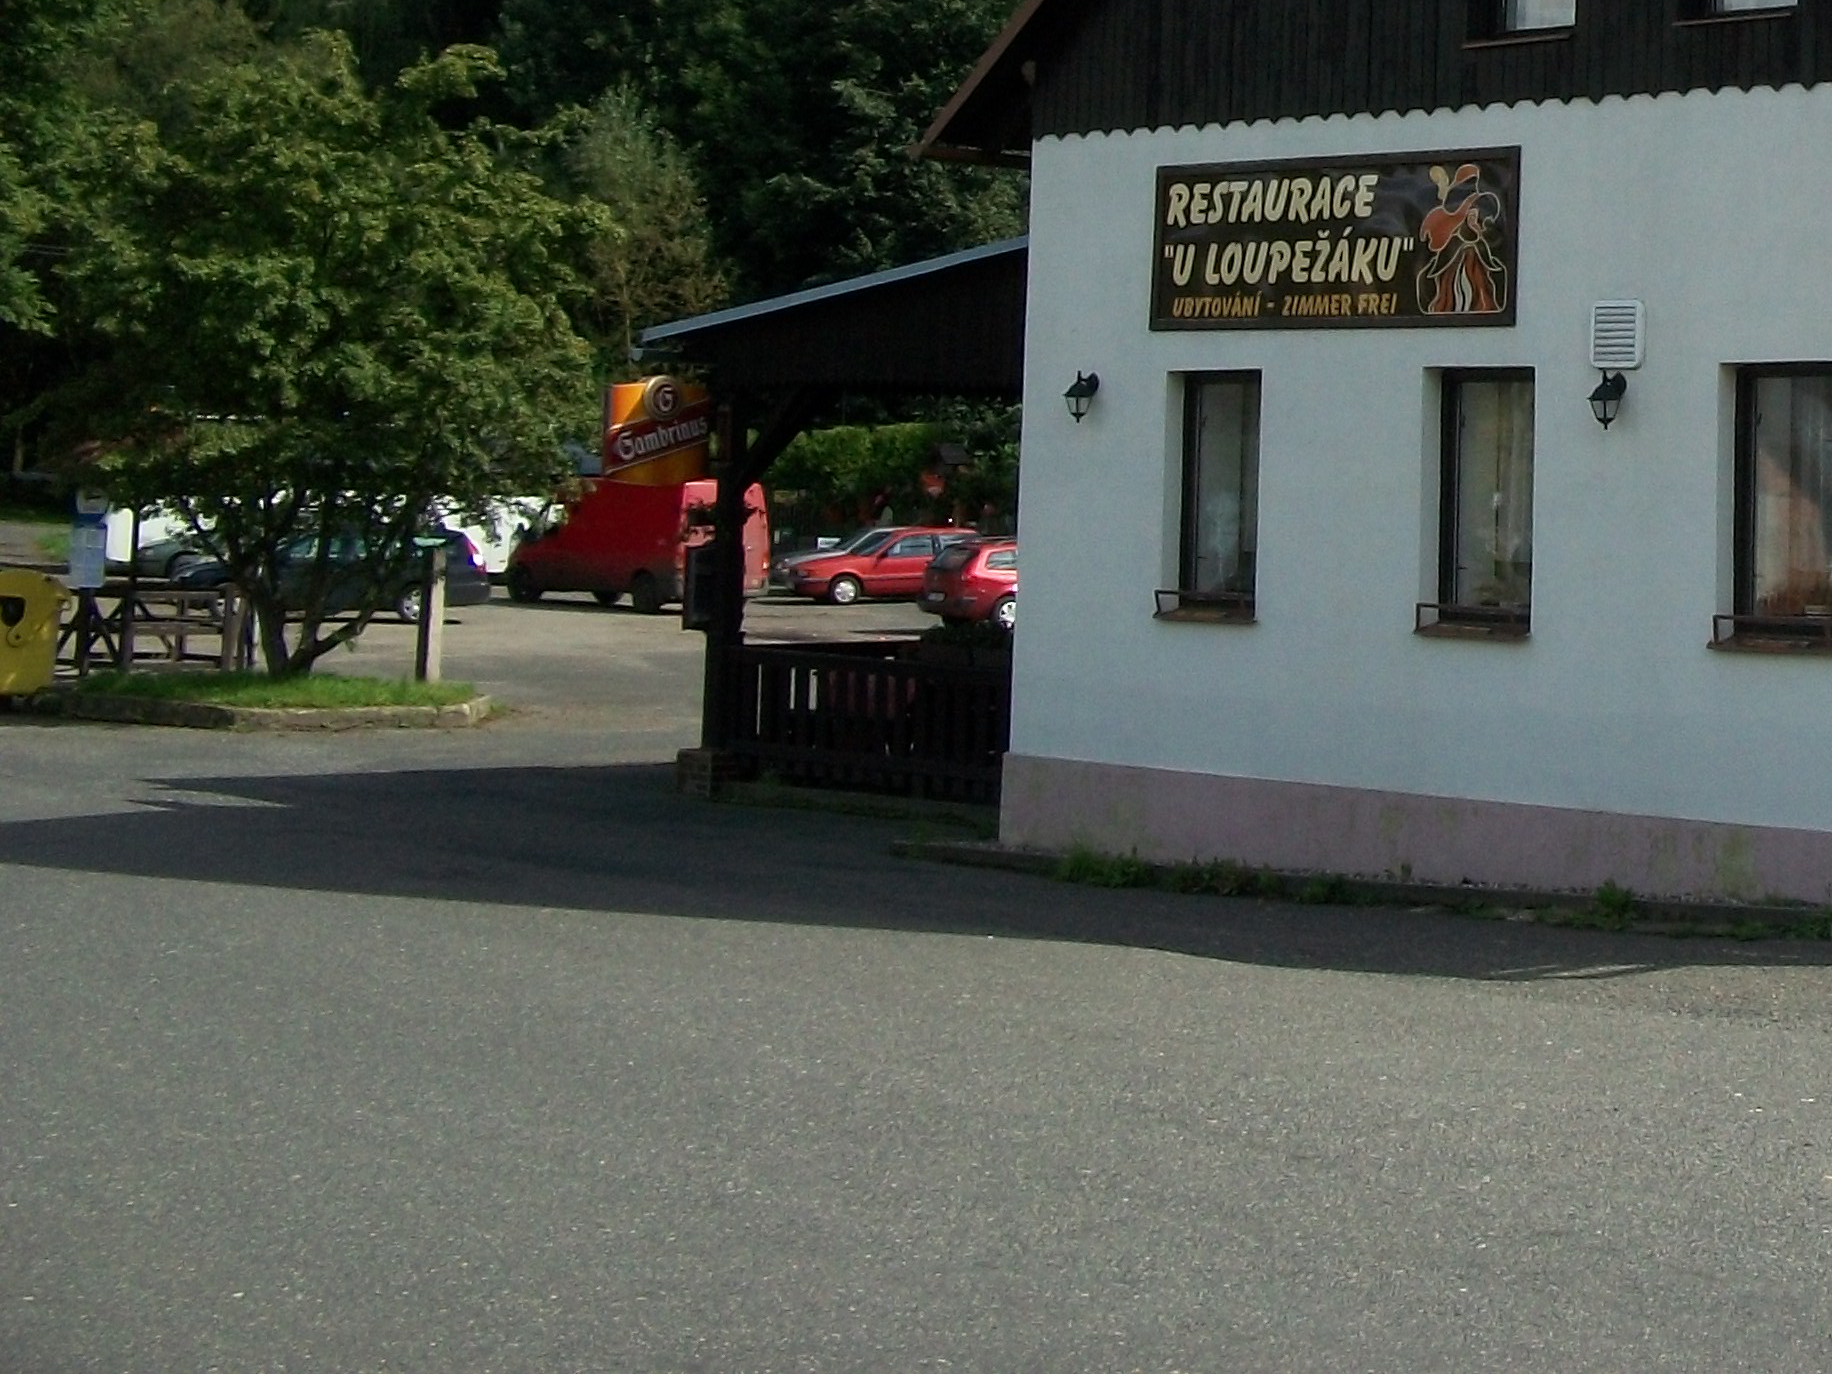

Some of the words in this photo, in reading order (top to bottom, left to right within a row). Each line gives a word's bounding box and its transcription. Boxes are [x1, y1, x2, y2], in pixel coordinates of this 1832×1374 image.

[1166, 174, 1379, 227] RESTAURACE
[1205, 226, 1414, 286] LOUPEŽÁKU"
[1172, 291, 1263, 319] UBYTOVÁNÍ
[1281, 293, 1351, 318] ZIMMER
[1357, 292, 1397, 316] FREI
[616, 416, 709, 461] Gambrinus
